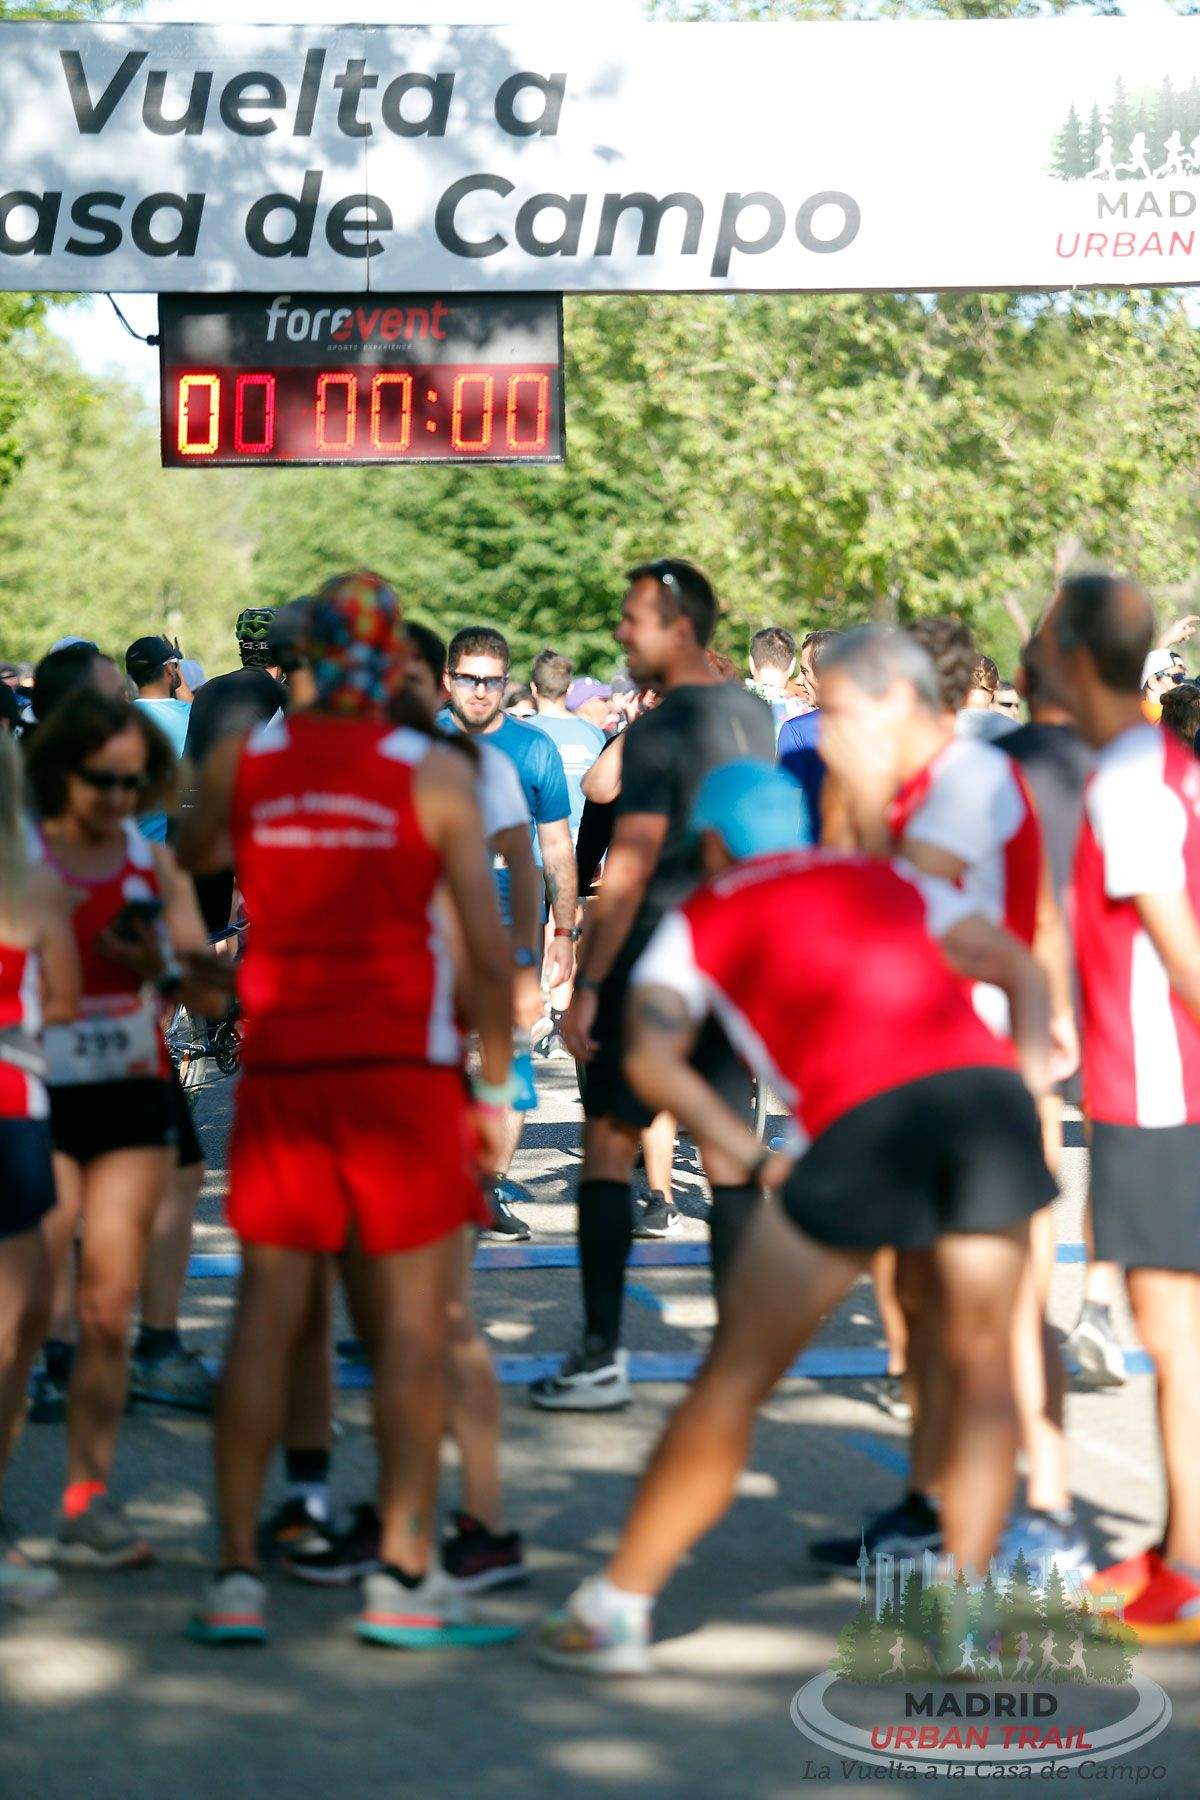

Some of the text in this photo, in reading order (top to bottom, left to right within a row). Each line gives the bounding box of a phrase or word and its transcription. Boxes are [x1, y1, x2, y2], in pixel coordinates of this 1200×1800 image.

[59, 48, 567, 137] Vuelta a
[0, 170, 861, 278] asa de Campo
[1097, 190, 1197, 219] MAD
[1055, 231, 1196, 258] URBAN
[266, 295, 449, 342] forevent
